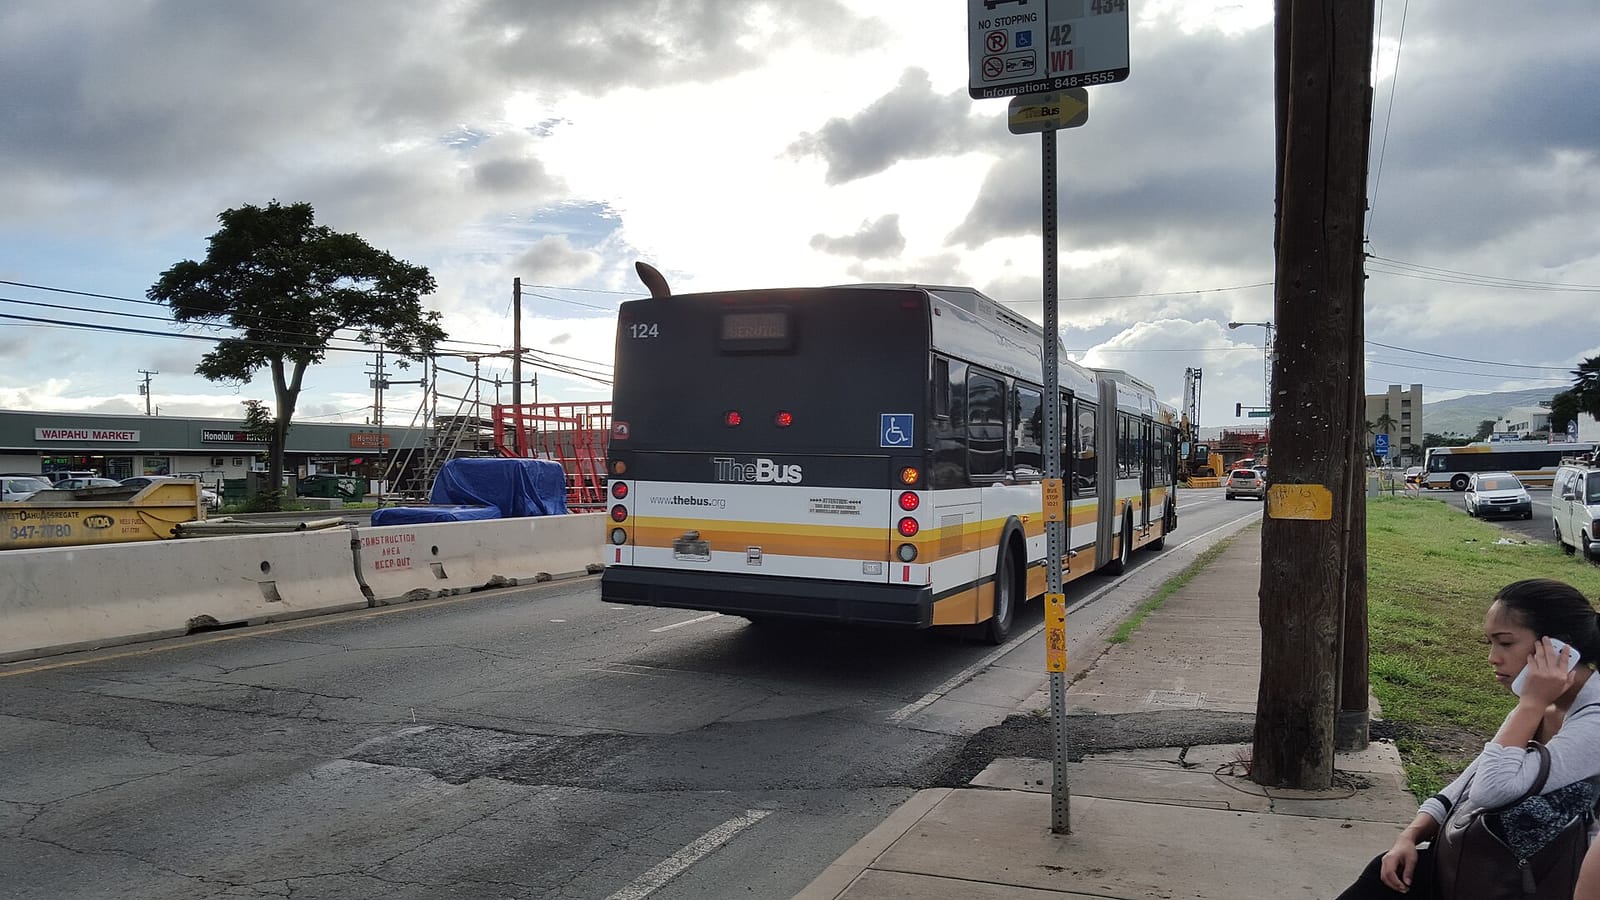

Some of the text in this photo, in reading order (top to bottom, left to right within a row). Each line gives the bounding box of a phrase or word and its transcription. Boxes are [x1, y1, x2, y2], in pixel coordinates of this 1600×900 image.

[978, 12, 1037, 30] NO STOPPING
[1050, 24, 1072, 46] 42
[1050, 49, 1073, 73] W1
[983, 72, 1115, 97] Information: 848-5555
[630, 323, 659, 338] 124
[41, 430, 135, 440] WAIPAHU MARKET
[204, 431, 234, 441] Honolulu
[713, 457, 802, 484] TheBus
[649, 495, 726, 510] www.thebus.org
[10, 524, 71, 539] 847-7780
[361, 533, 416, 546] CONSTRUCTION
[382, 547, 401, 556] AREA
[396, 557, 411, 567] OUT
